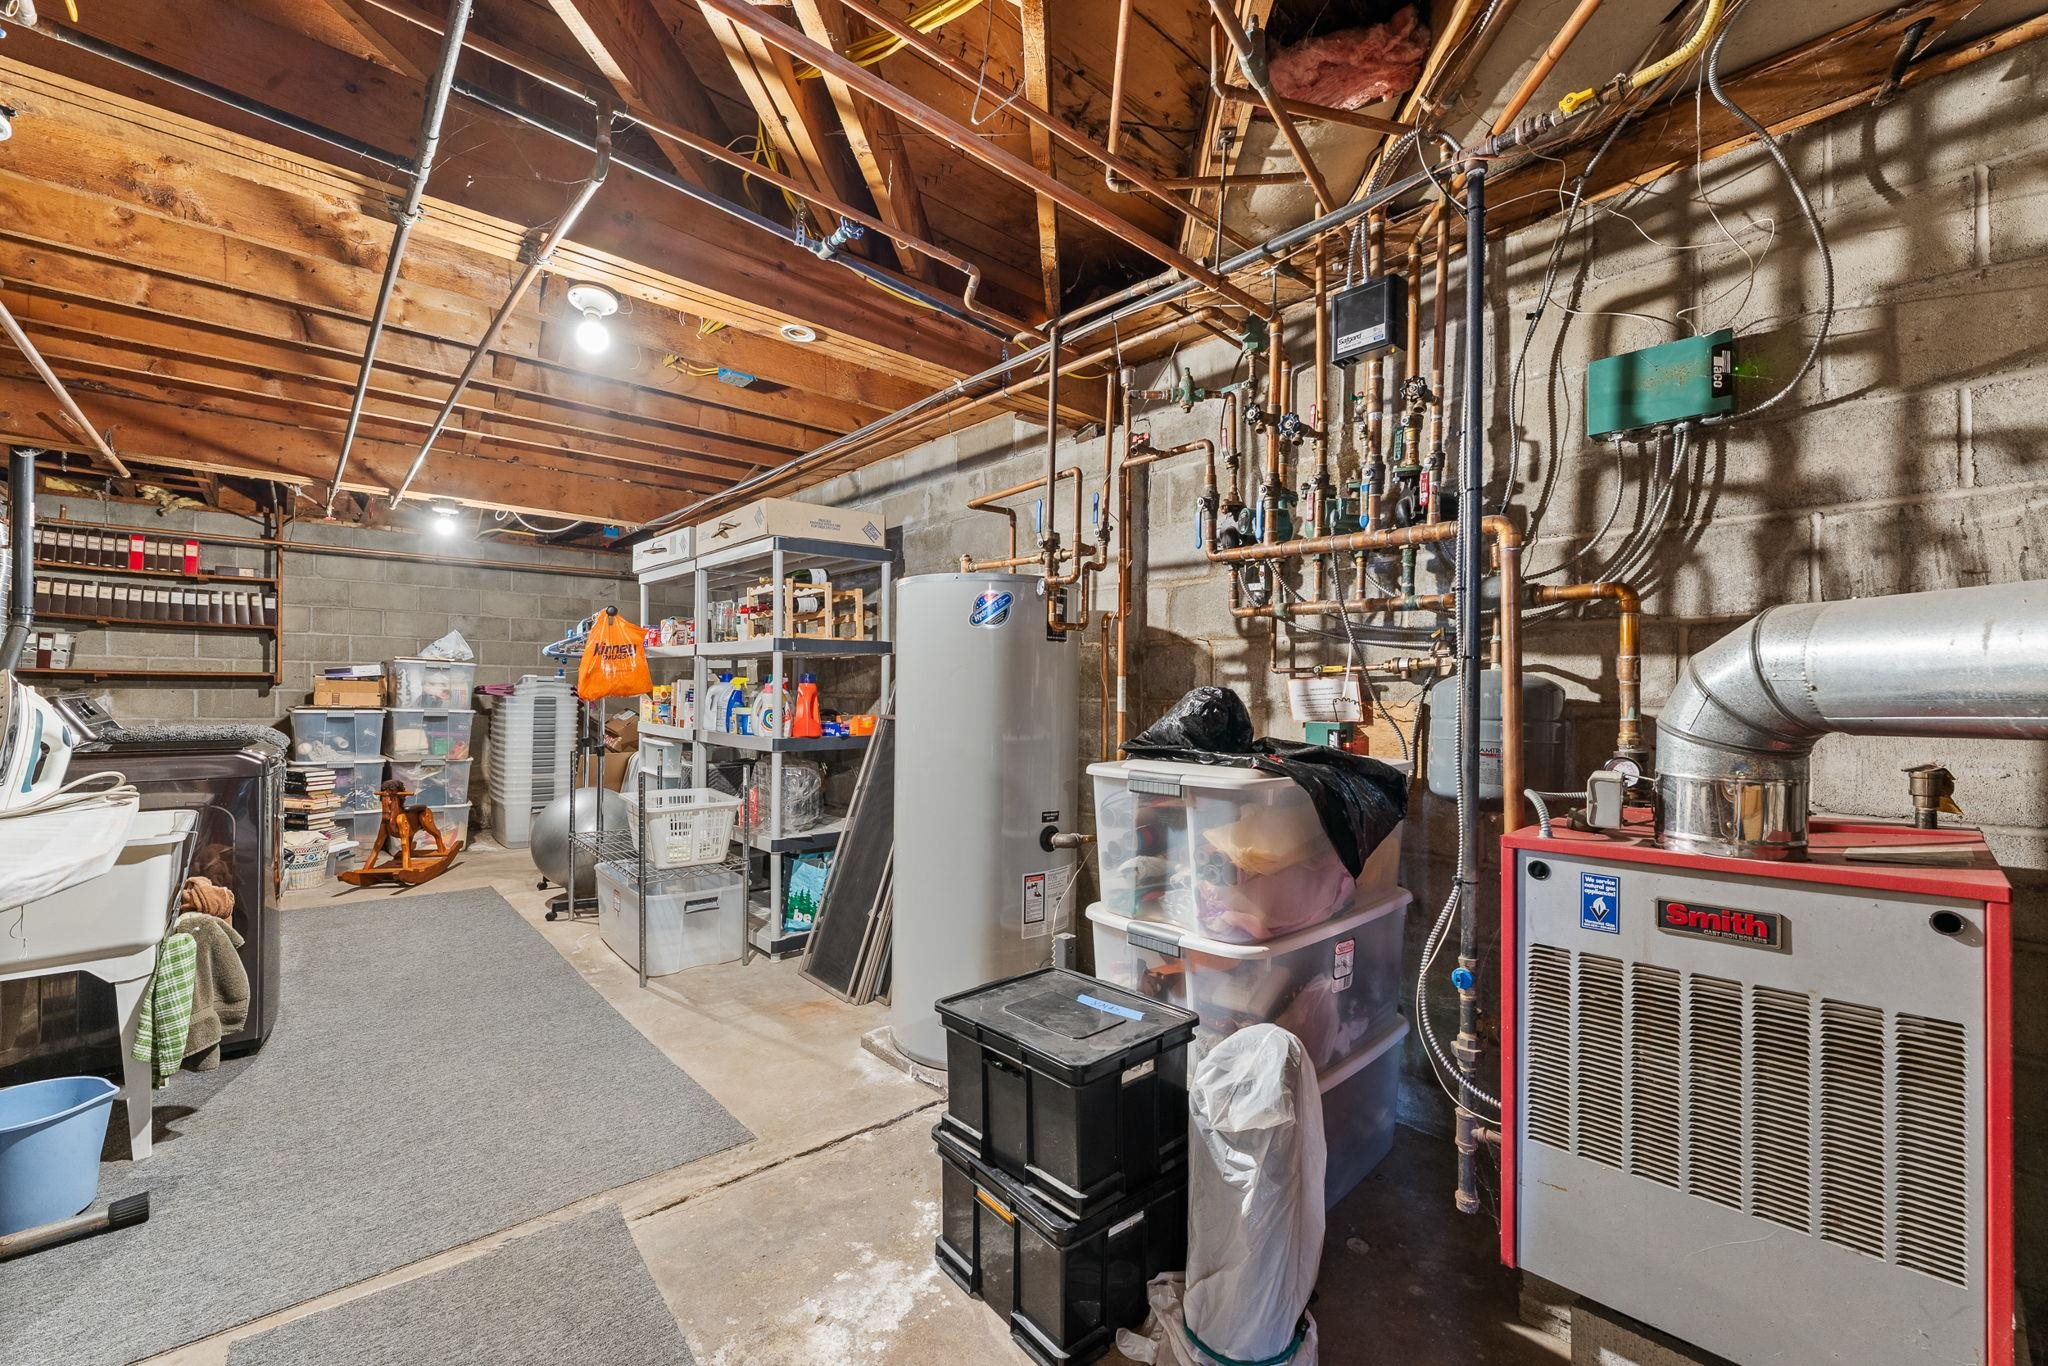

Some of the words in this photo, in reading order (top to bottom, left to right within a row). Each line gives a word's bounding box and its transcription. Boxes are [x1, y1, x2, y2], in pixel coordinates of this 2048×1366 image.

[1713, 350, 1730, 388] Taco
[593, 641, 637, 656] Kinney
[1480, 747, 1503, 755] AMTR
[793, 908, 812, 923] be
[1666, 903, 1768, 938] Smith
